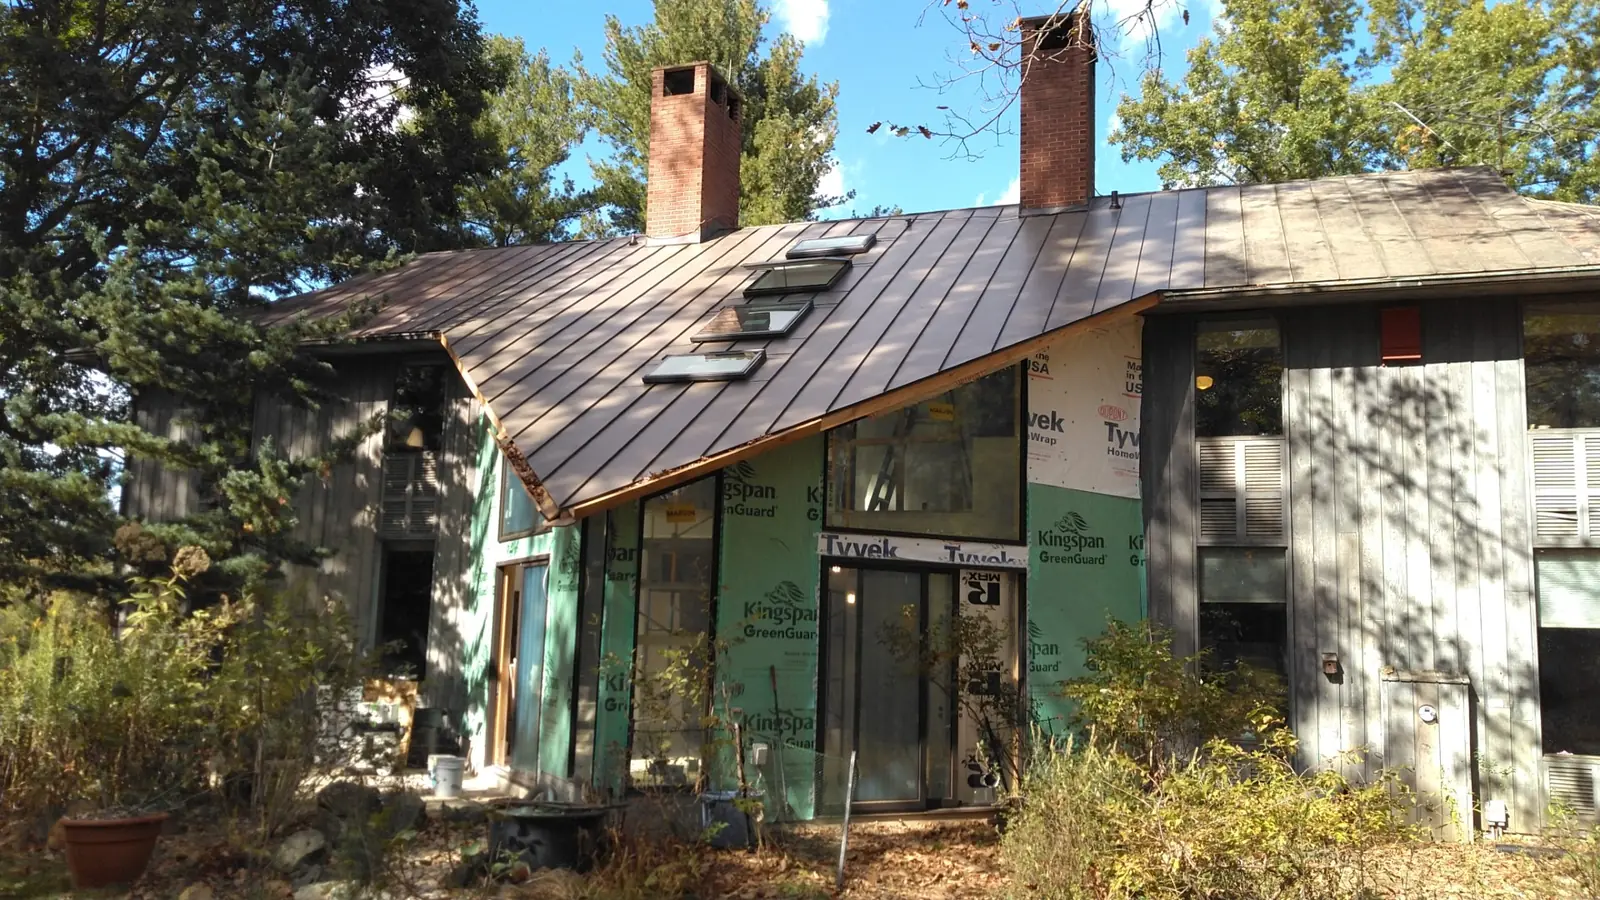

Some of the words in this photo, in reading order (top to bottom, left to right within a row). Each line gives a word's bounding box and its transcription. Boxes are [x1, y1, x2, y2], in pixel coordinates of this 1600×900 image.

[724, 503, 775, 518] nGuard
[1038, 529, 1104, 552] Kingspan
[1039, 550, 1105, 565] GreenGuard
[743, 623, 818, 640] GreenGuar
[1028, 642, 1059, 660] pan
